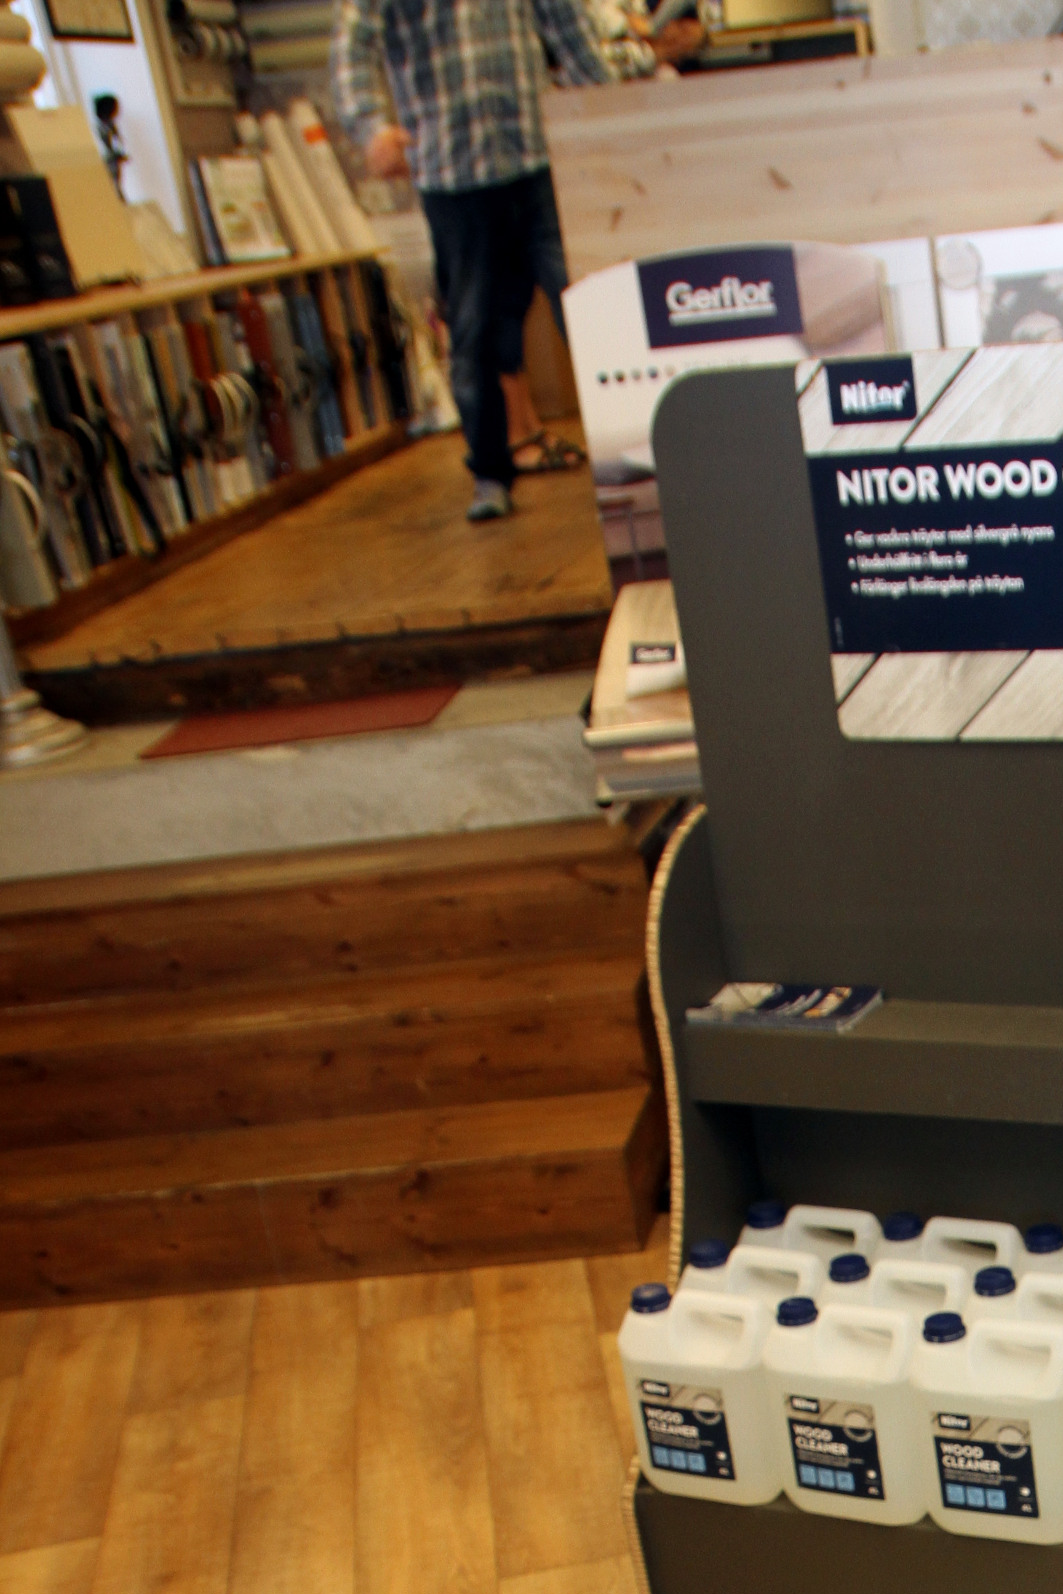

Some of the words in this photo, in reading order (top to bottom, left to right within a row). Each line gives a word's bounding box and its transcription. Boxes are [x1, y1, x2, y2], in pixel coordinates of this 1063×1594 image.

[666, 276, 774, 313] Gerflor
[840, 380, 907, 413] Nitor
[836, 464, 941, 507] NITOR
[943, 458, 1058, 501] WOOD
[644, 1406, 684, 1424] WOOD
[792, 1423, 833, 1442] WOOD
[795, 1435, 849, 1457] CLEANER
[940, 1442, 984, 1460] WOOD
[942, 1454, 1001, 1474] CLEANER
